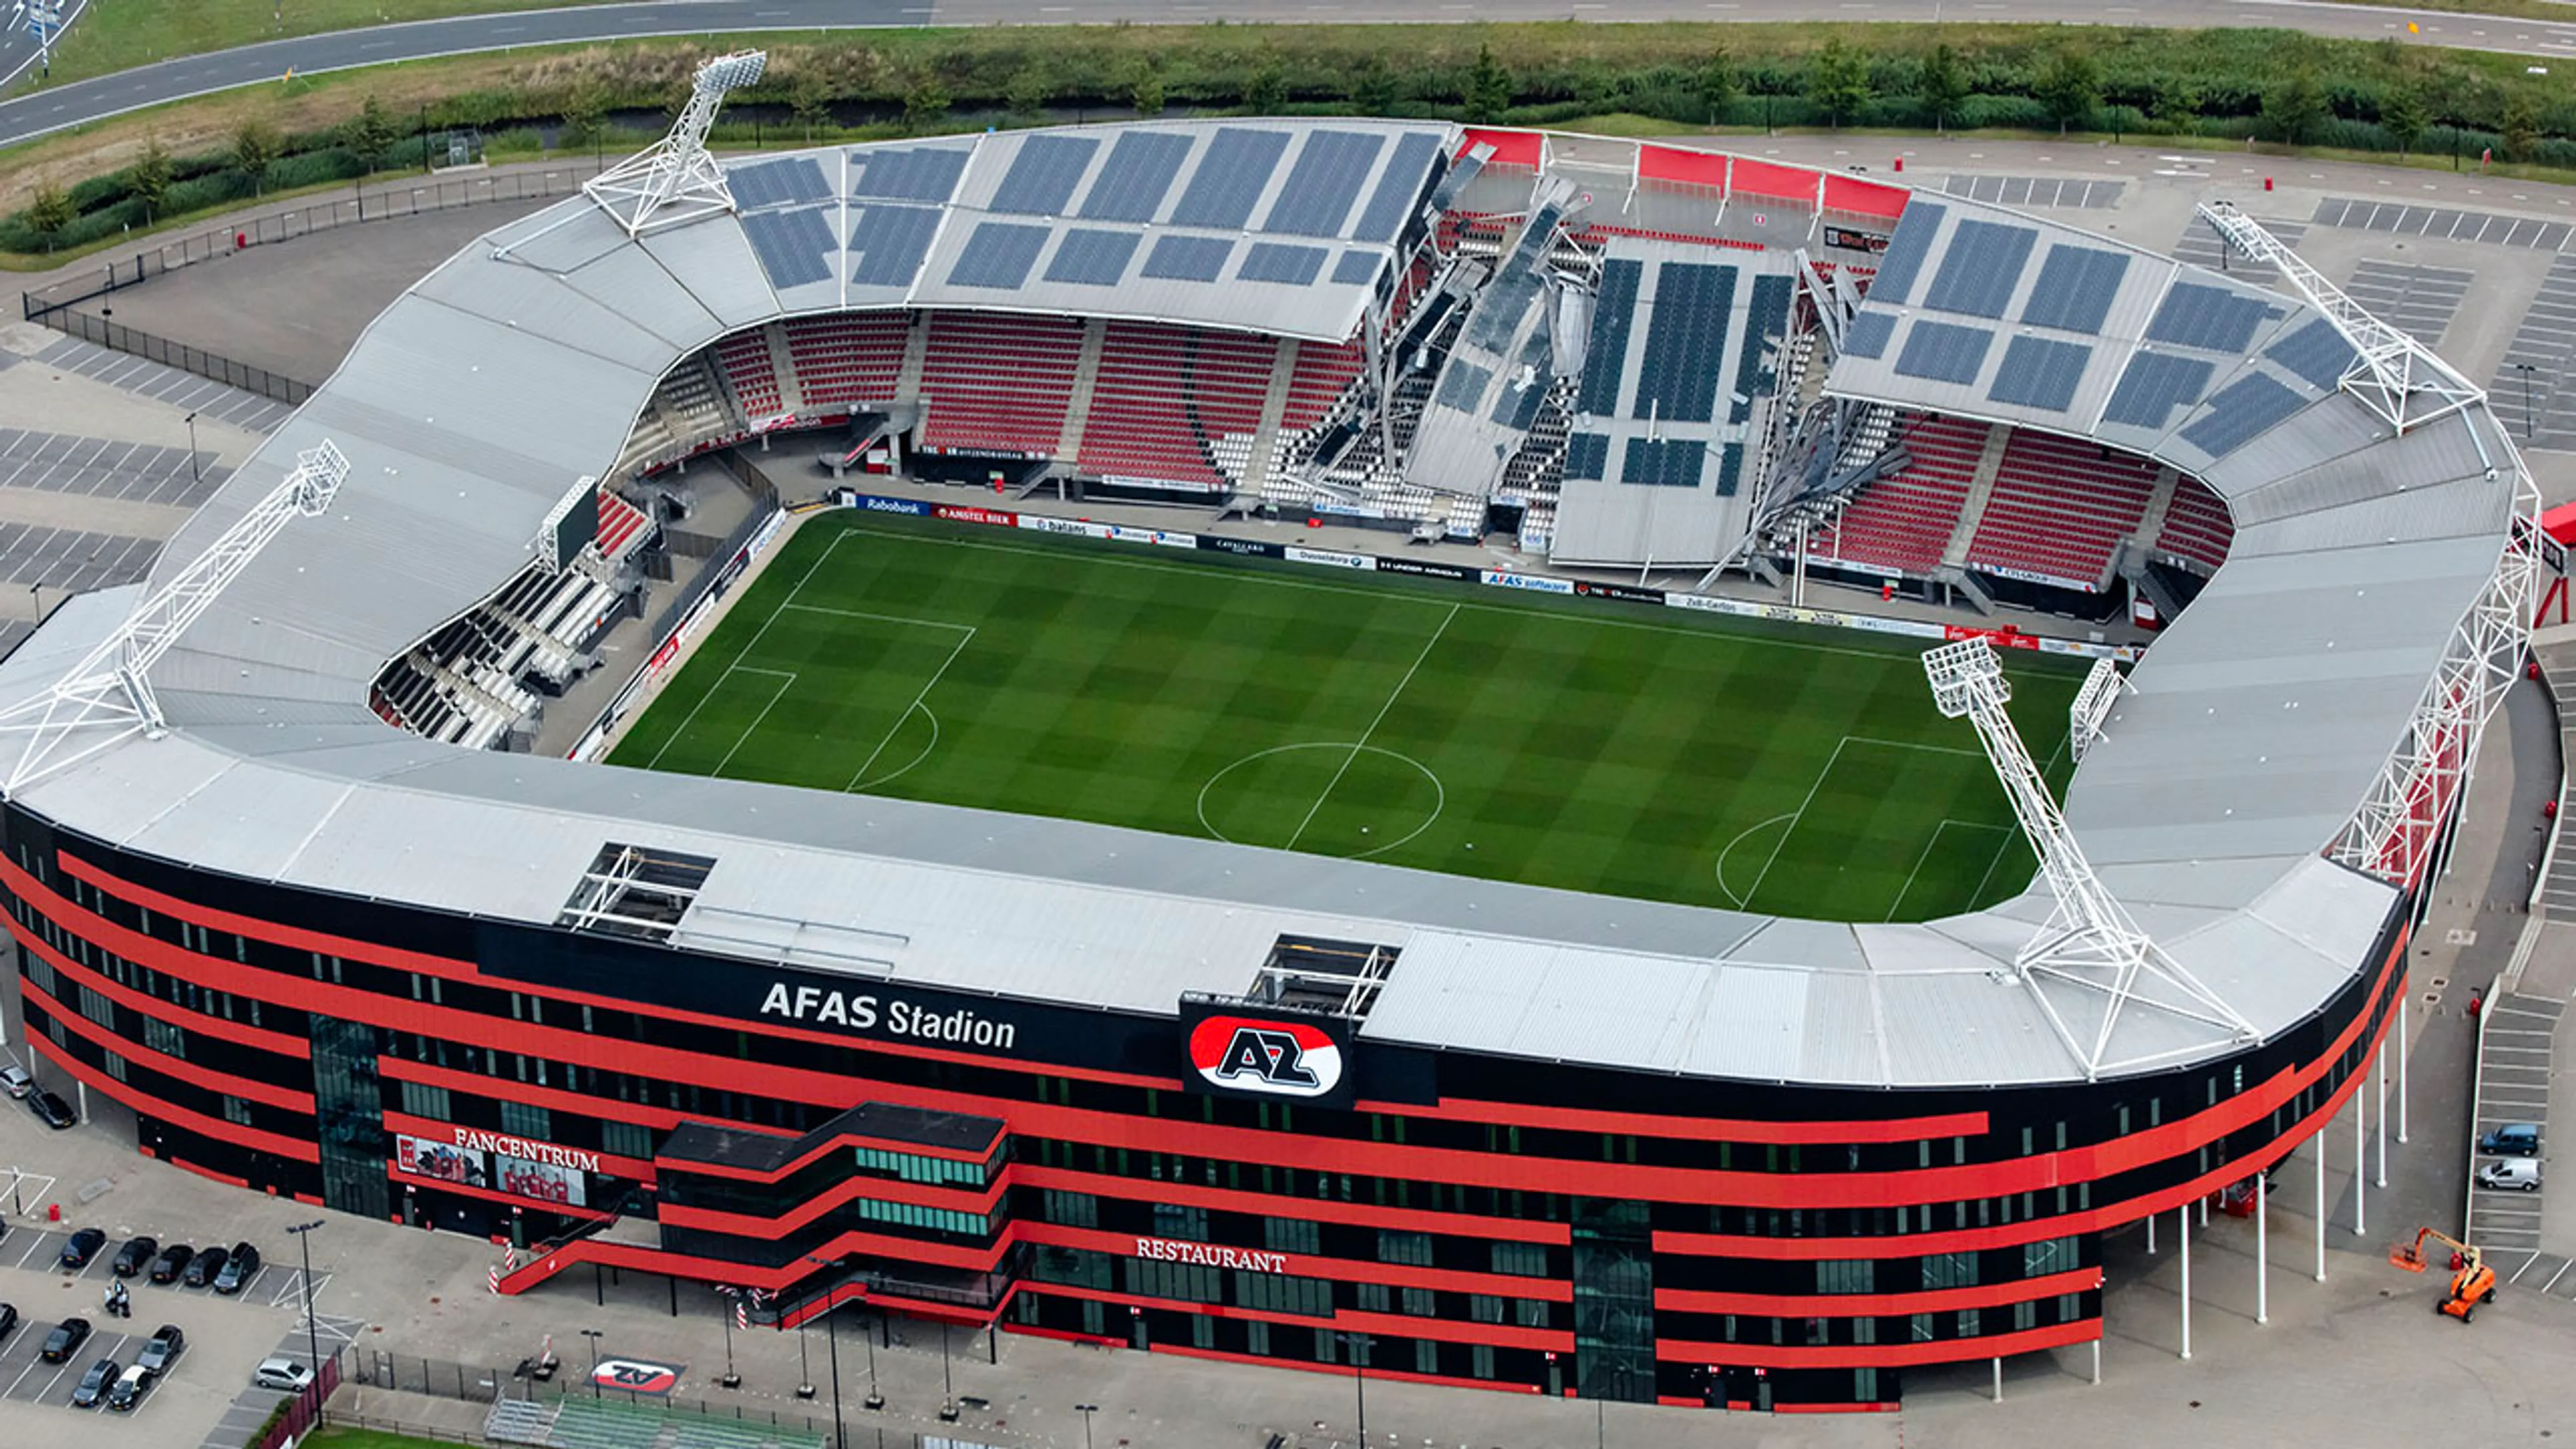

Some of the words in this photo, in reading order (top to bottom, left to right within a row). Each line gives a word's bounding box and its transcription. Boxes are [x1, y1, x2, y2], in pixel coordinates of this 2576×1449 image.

[867, 498, 919, 514] Rabobank
[948, 508, 984, 522] AMSTEL
[987, 514, 1009, 525] BIER
[1393, 563, 1423, 572] UNDER
[1424, 565, 1462, 578] ARMOUR
[1489, 574, 1522, 586] AFAS
[1525, 578, 1568, 590] software
[760, 982, 877, 1029] AFAS
[887, 1000, 1016, 1049] Stadion
[1216, 1027, 1320, 1088] AZ
[453, 1128, 600, 1173] FANCENTRUM
[1136, 1238, 1285, 1273] RESTAURANT
